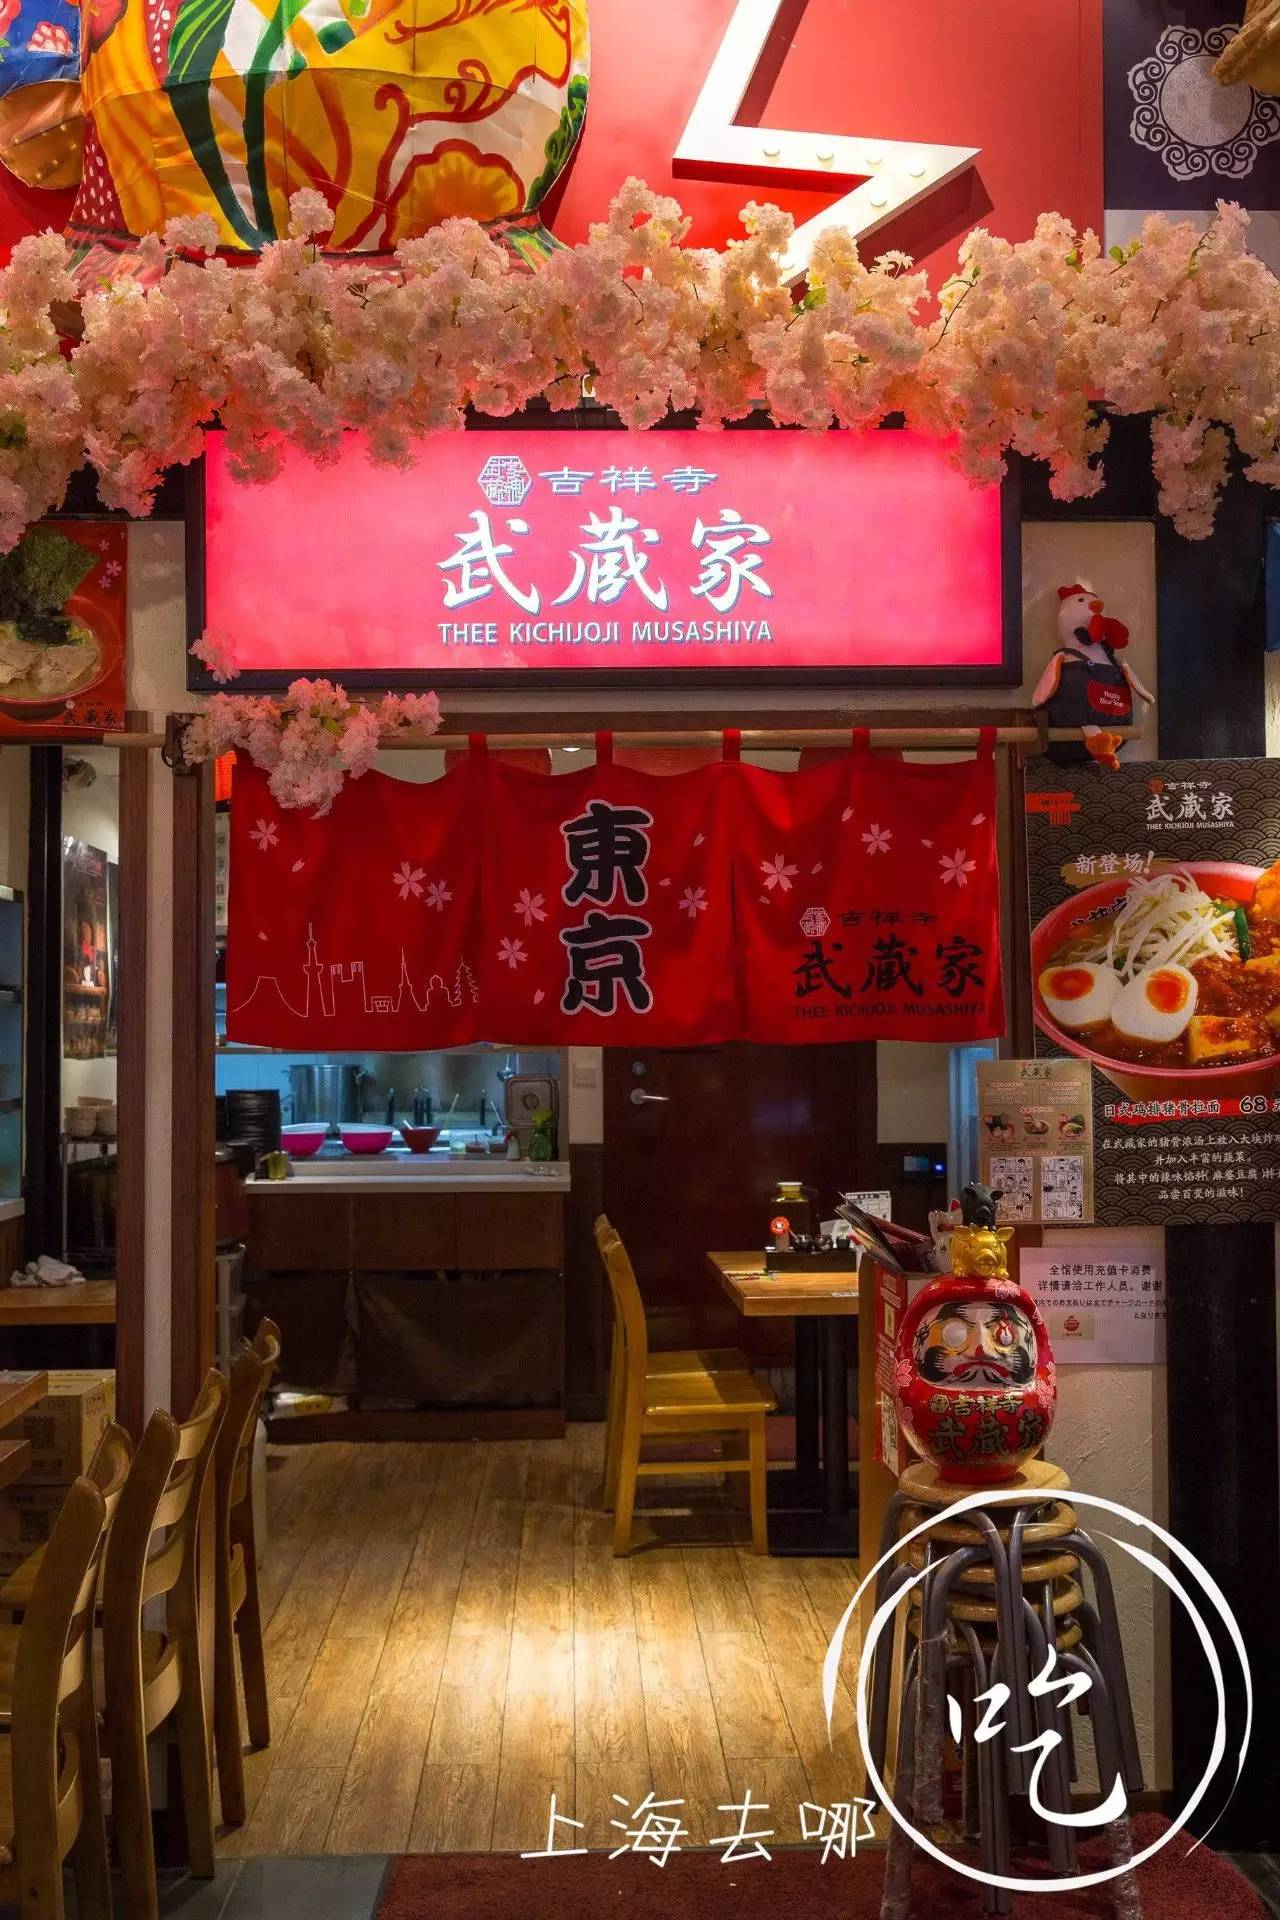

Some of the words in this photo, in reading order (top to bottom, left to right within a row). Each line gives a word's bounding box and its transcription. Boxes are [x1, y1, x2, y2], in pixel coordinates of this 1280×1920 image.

[538, 465, 719, 496] 吉祥寺
[437, 622, 498, 646] THEE
[509, 621, 620, 645] KICHIJOJI
[631, 619, 774, 645] MUSASHIYA
[559, 799, 654, 1016] 東京
[838, 911, 937, 927] 吉祥寺
[1104, 1099, 1221, 1118] 日式鸡排猪骨拉面
[1239, 1095, 1268, 1114] 68
[1049, 1264, 1152, 1276] 全馆使用充值卡消费
